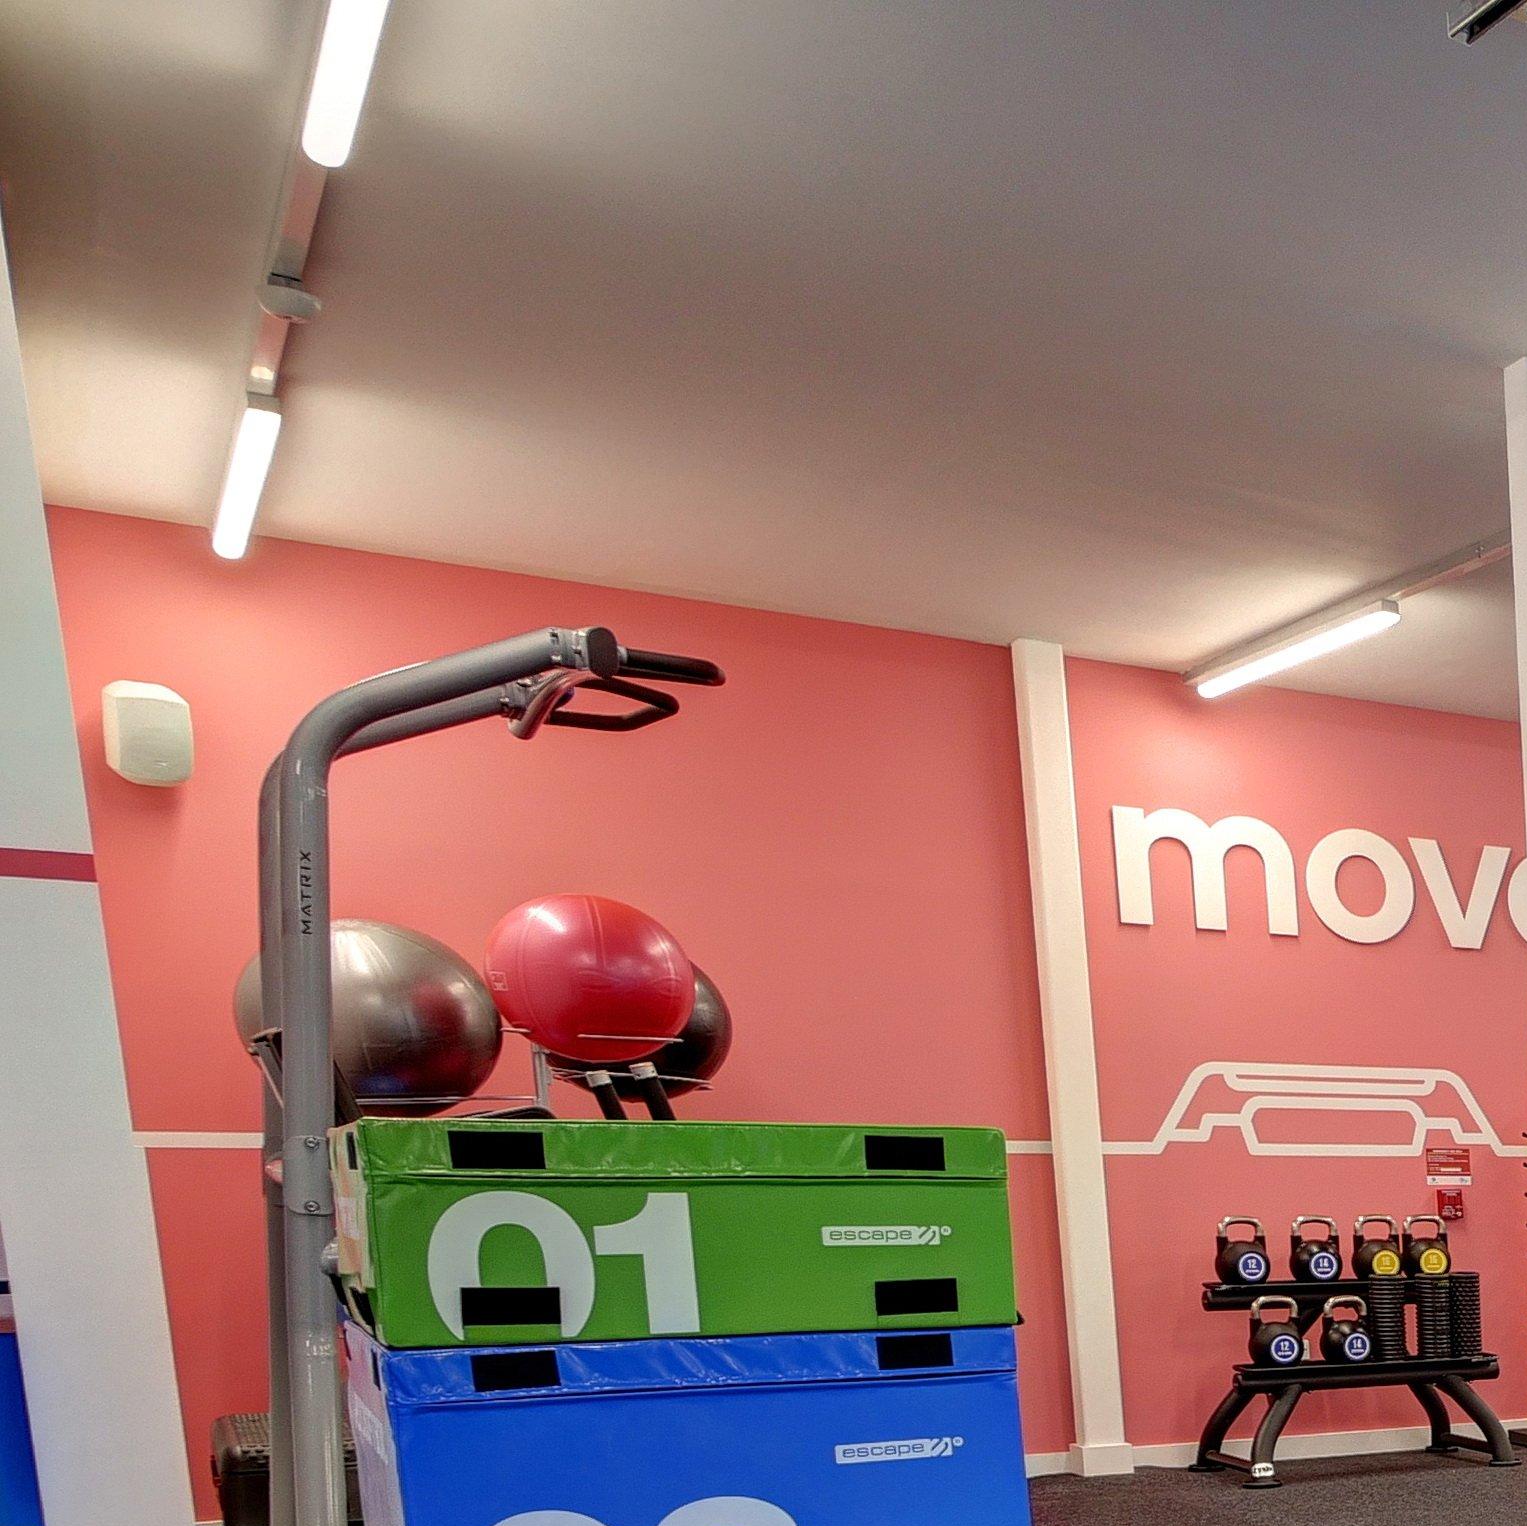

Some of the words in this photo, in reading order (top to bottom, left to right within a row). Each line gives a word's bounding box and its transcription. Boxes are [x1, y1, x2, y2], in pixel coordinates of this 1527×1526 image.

[299, 851, 312, 935] MATRIX
[829, 1229, 912, 1243] escape
[427, 1190, 702, 1340] 01
[1247, 1259, 1257, 1269] 12
[1280, 1341, 1289, 1351] 12
[842, 1443, 925, 1458] escape
